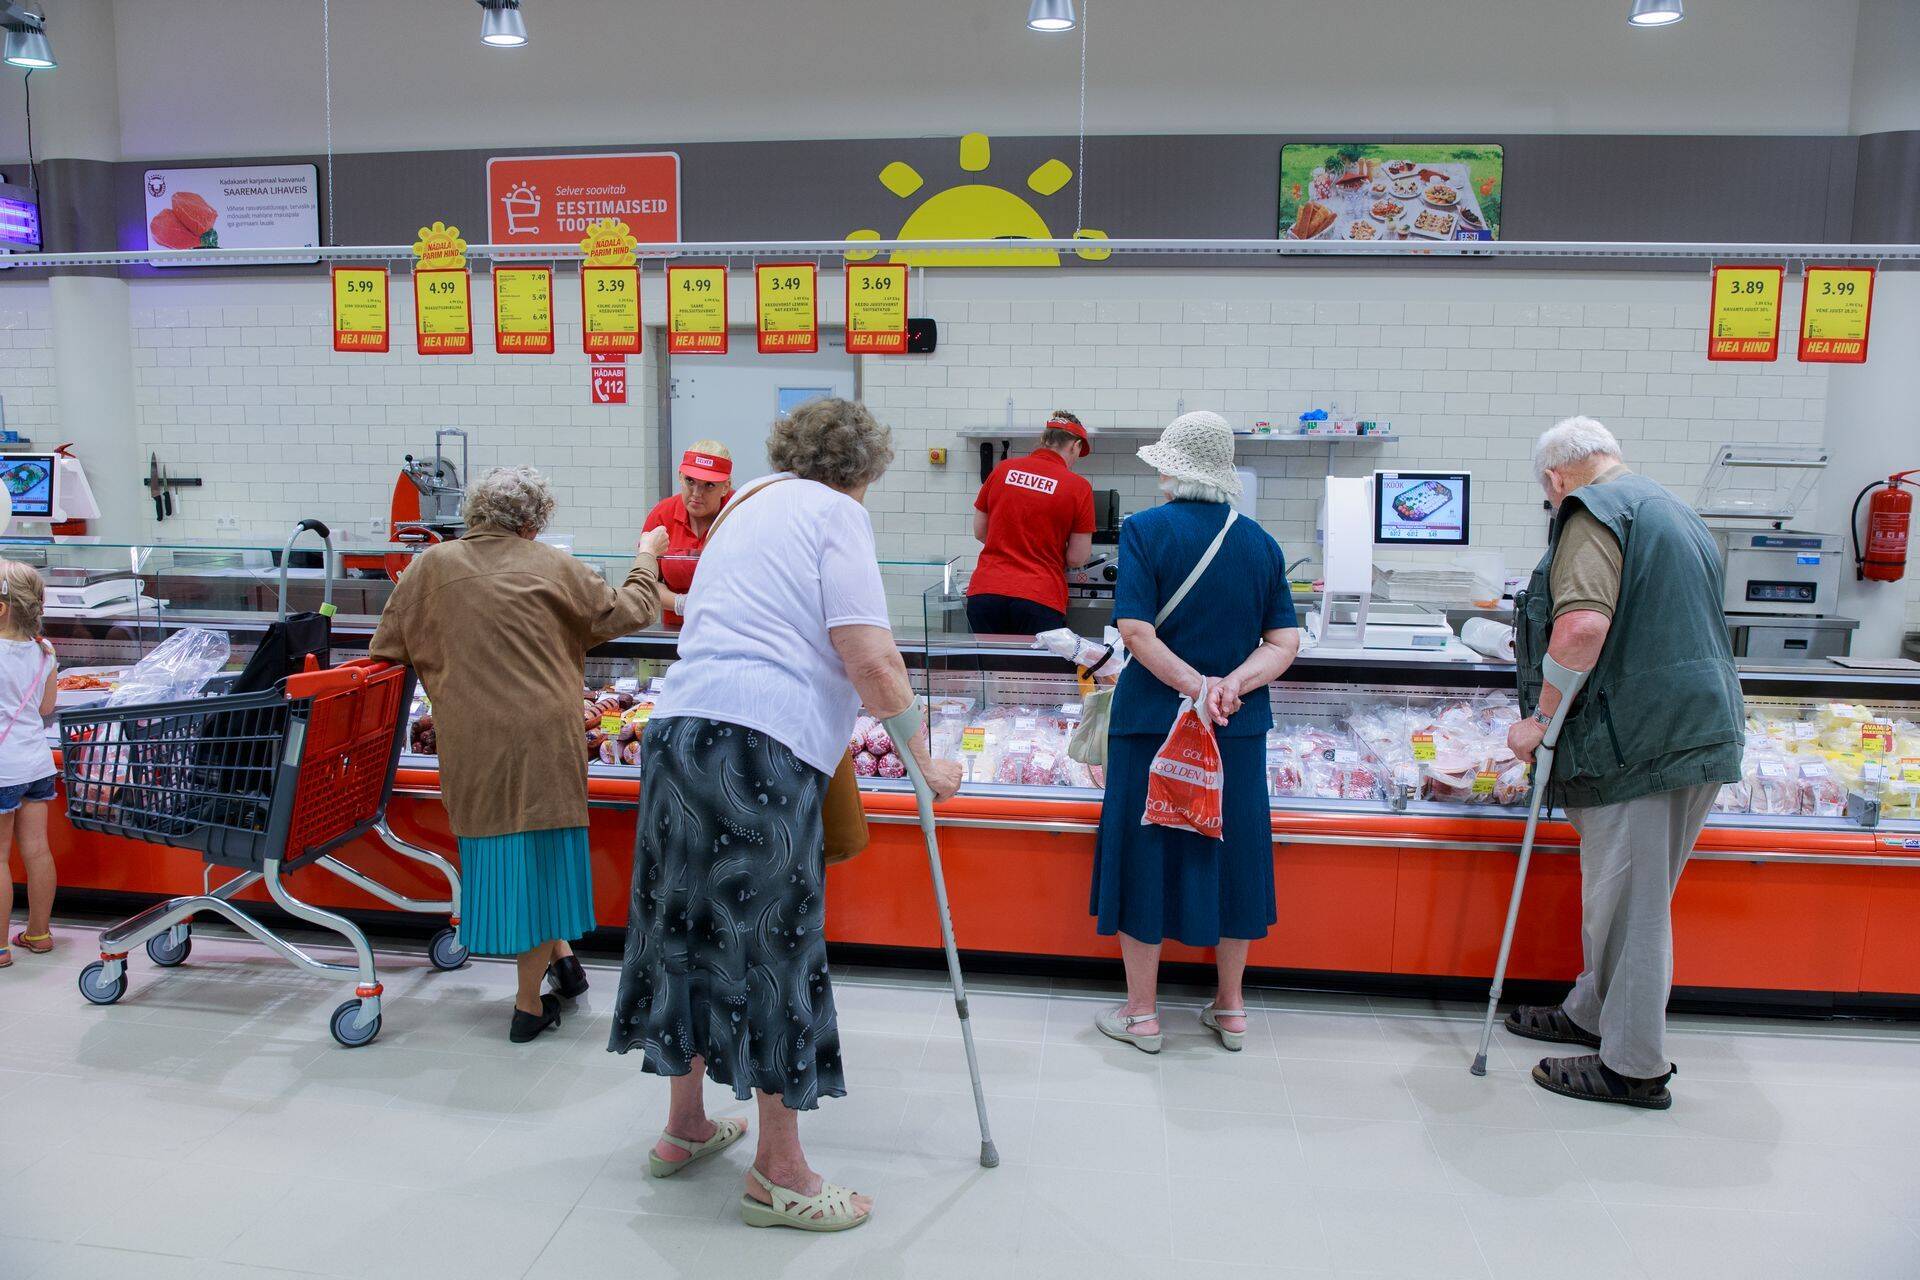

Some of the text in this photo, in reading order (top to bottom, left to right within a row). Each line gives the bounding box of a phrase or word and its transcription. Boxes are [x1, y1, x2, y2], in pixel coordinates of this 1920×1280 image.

[278, 176, 306, 184] kasvanud
[224, 185, 308, 197] SAAREMAA LIHAVEIS
[555, 184, 626, 196] Selver soovitab
[556, 199, 668, 215] EESTIMAISEID
[557, 217, 621, 232] TOOTED
[423, 249, 460, 260] PARIM HIND
[591, 246, 630, 257] PARIM HIND
[531, 273, 546, 281] 7.49
[347, 280, 373, 293] 5.99
[429, 282, 455, 294] 4.99
[597, 279, 625, 292] 3.39
[683, 279, 711, 292] 4.99
[772, 277, 800, 290] 3.49
[862, 277, 891, 290] 3.69
[1730, 281, 1764, 294] 3.89
[1822, 282, 1855, 295] 3.99
[532, 293, 547, 301] 5.49
[340, 333, 383, 344] HEA HIND
[423, 336, 466, 347] HEA HIND
[502, 335, 548, 346] HEA HIND
[590, 335, 635, 346] HEA HIND
[675, 335, 722, 346] HEA HIND
[764, 334, 811, 345] HEA HIND
[853, 334, 900, 345] HEA HIND
[1716, 341, 1771, 353] HEA HIND
[1806, 341, 1861, 354] HEA HIND
[604, 380, 624, 394] 112
[1008, 471, 1054, 492] SELVER
[1155, 761, 1202, 781] GOLDEN
